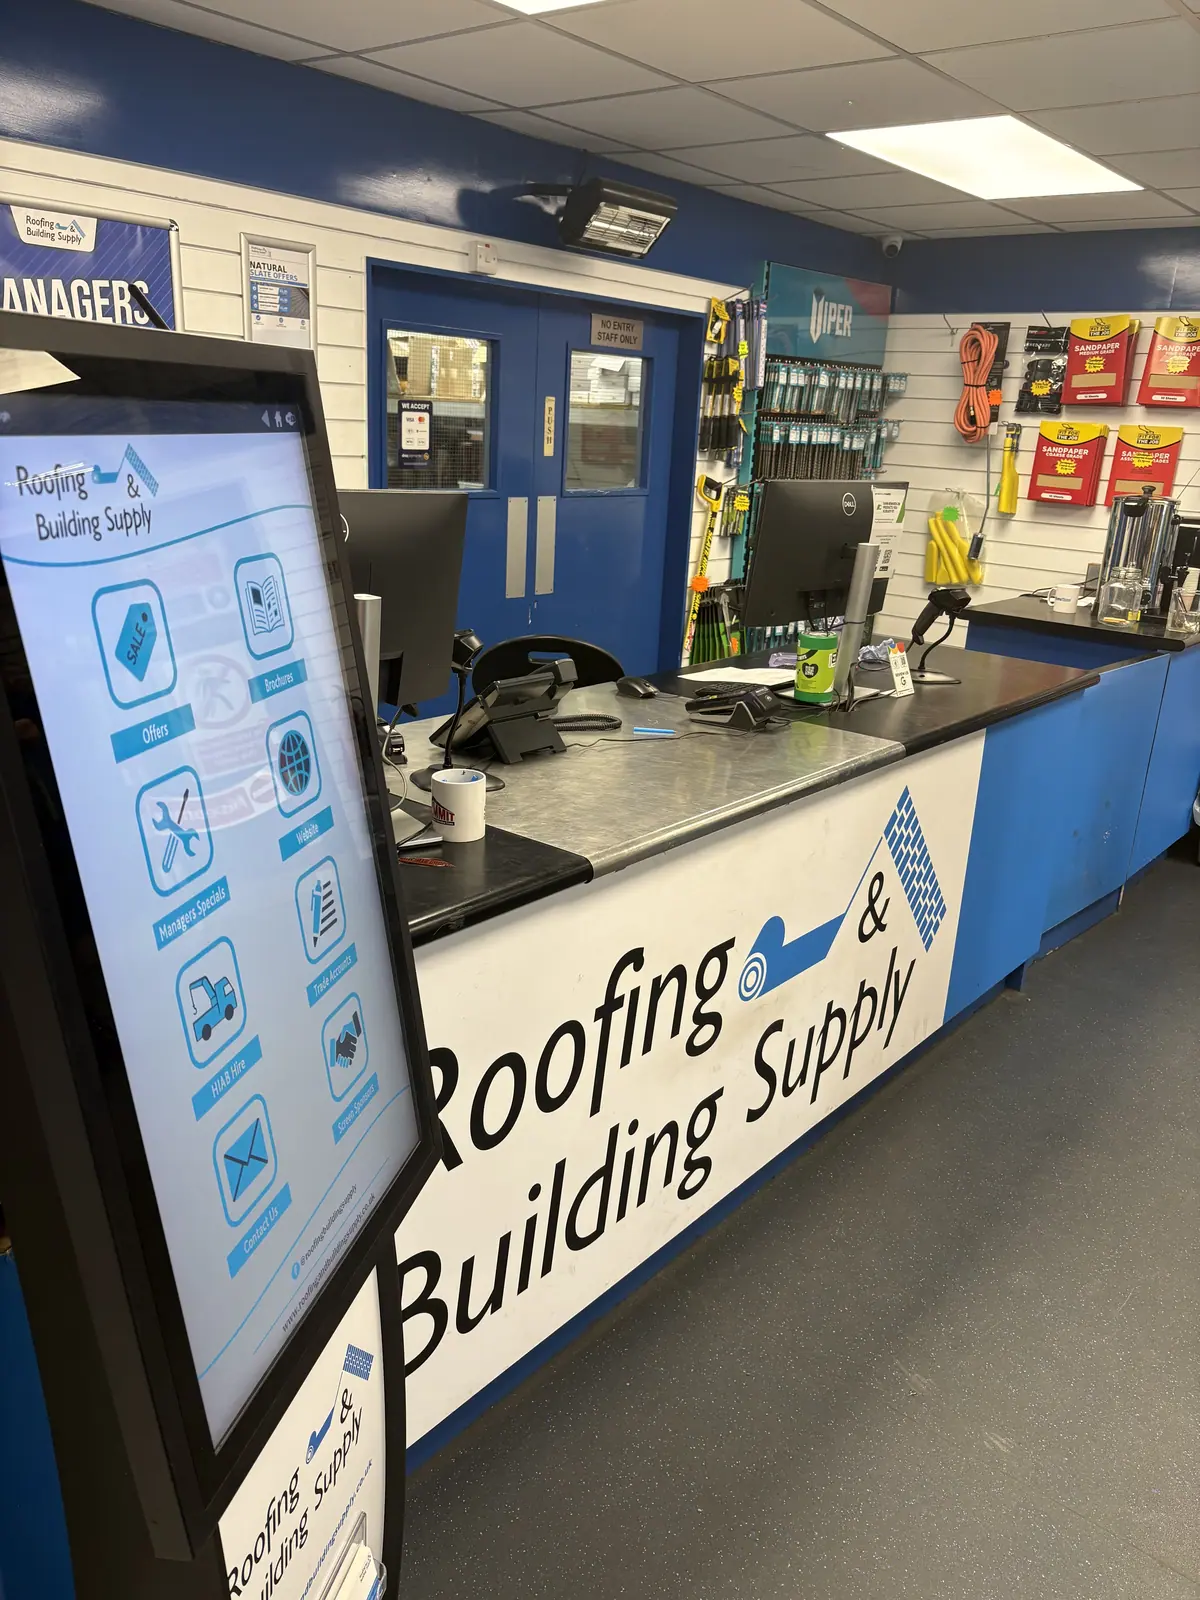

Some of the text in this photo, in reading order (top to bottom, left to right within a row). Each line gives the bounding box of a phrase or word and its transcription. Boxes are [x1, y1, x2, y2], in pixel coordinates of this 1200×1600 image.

[26, 214, 76, 233] Roofing &
[26, 227, 81, 245] Building Supply
[249, 261, 287, 273] NATURAL
[249, 269, 298, 281] SLATE OFFERS
[600, 319, 635, 333] NO ENTRY
[810, 292, 853, 344] VIPER
[597, 331, 638, 345] STAFF ONLY
[1074, 342, 1120, 352] SANDPAPER
[1042, 446, 1089, 456] SANDPAPER
[16, 464, 141, 500] Roofing &
[36, 503, 152, 541] Building Supply
[126, 622, 147, 665] SALE
[264, 671, 294, 693] Brochures
[142, 723, 169, 744] Offers
[296, 822, 319, 846] Website
[158, 886, 226, 941] Managers Specials
[858, 872, 891, 944] &
[313, 955, 352, 998] Trade Accounts
[211, 1059, 246, 1098] HIAB Hire
[337, 1083, 375, 1133] Screen Sponsors
[398, 946, 916, 1379] Building Supply
[243, 1206, 279, 1254] Contact Us
[314, 1407, 362, 1511] Supply
[228, 1388, 353, 1597] Roofing &
